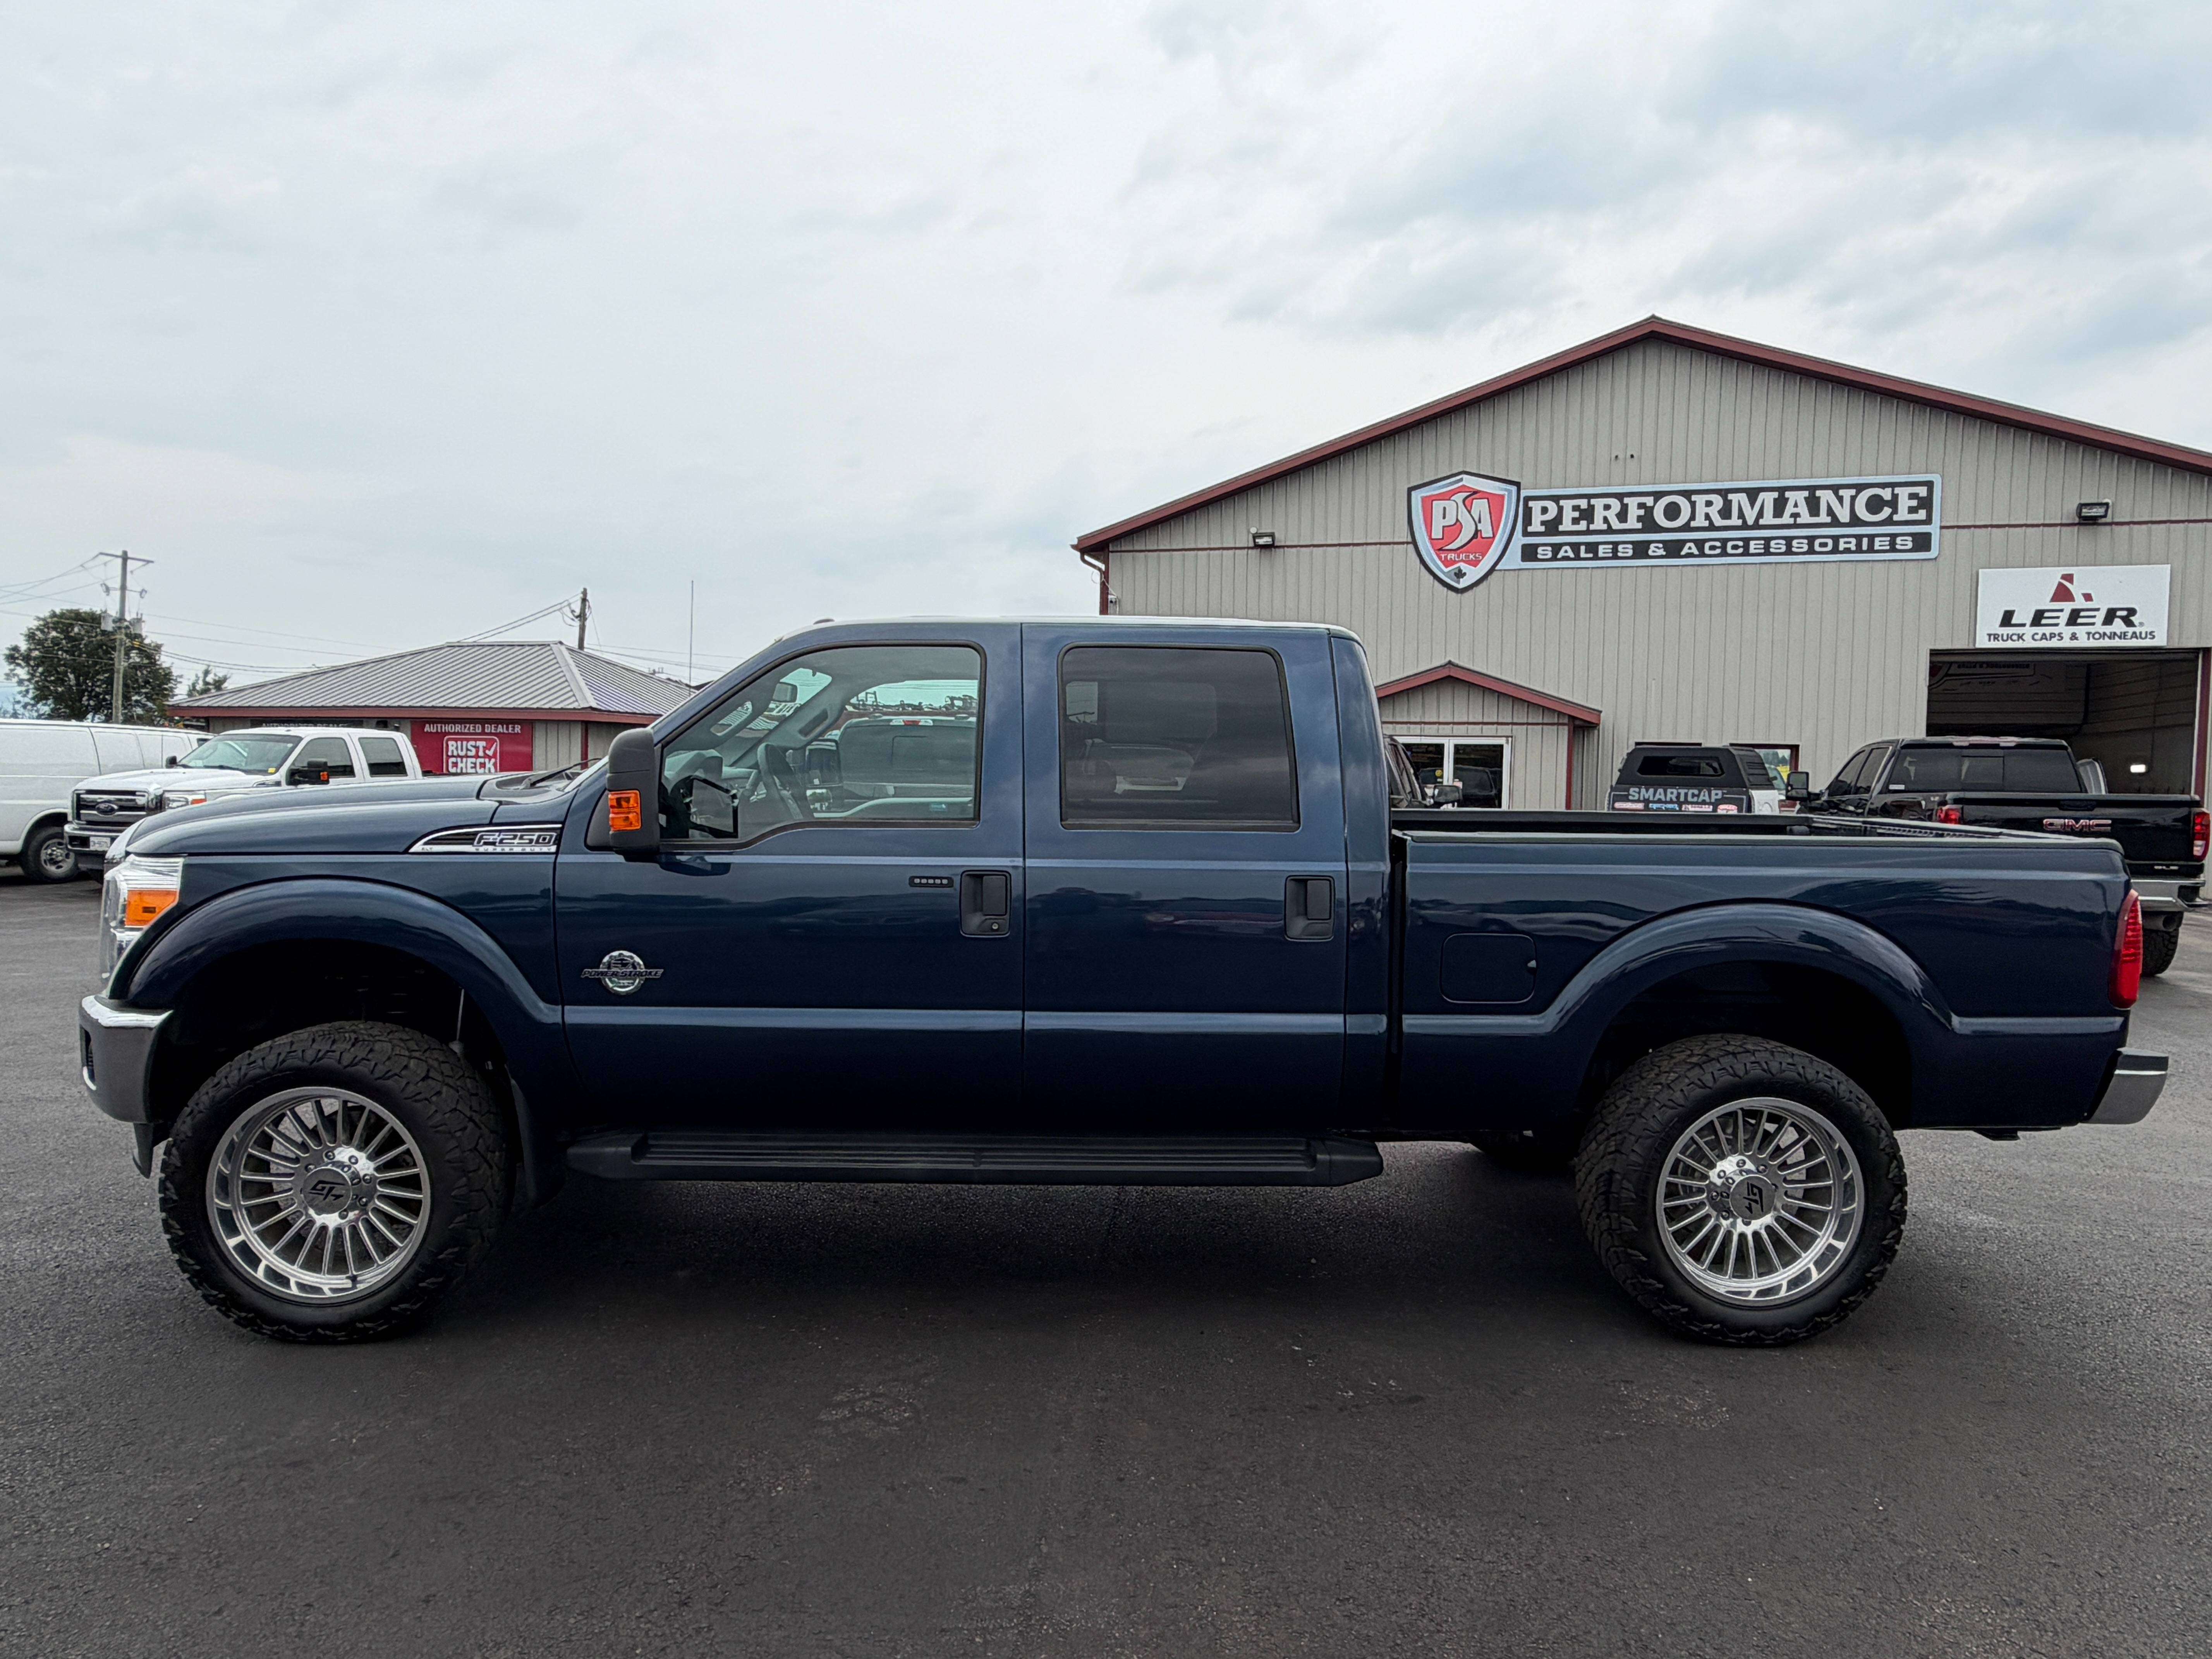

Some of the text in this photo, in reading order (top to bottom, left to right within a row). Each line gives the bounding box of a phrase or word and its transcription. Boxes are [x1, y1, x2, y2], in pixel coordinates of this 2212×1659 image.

[1527, 486, 1928, 532] PERFORMANCE
[1431, 492, 1494, 550] PSA
[1537, 536, 1914, 559] SALES & ACCESSORIES
[1998, 606, 2138, 628] LEER
[1987, 630, 2156, 642] TRUCK CAPS & TONNEAUS
[424, 723, 521, 733] AUTHORIZED DEALER
[448, 741, 486, 756] RUST
[448, 757, 495, 773] CHECK
[1628, 787, 1723, 802] SMARTCAP
[2043, 819, 2112, 832] GMC
[474, 832, 557, 847] F-250
